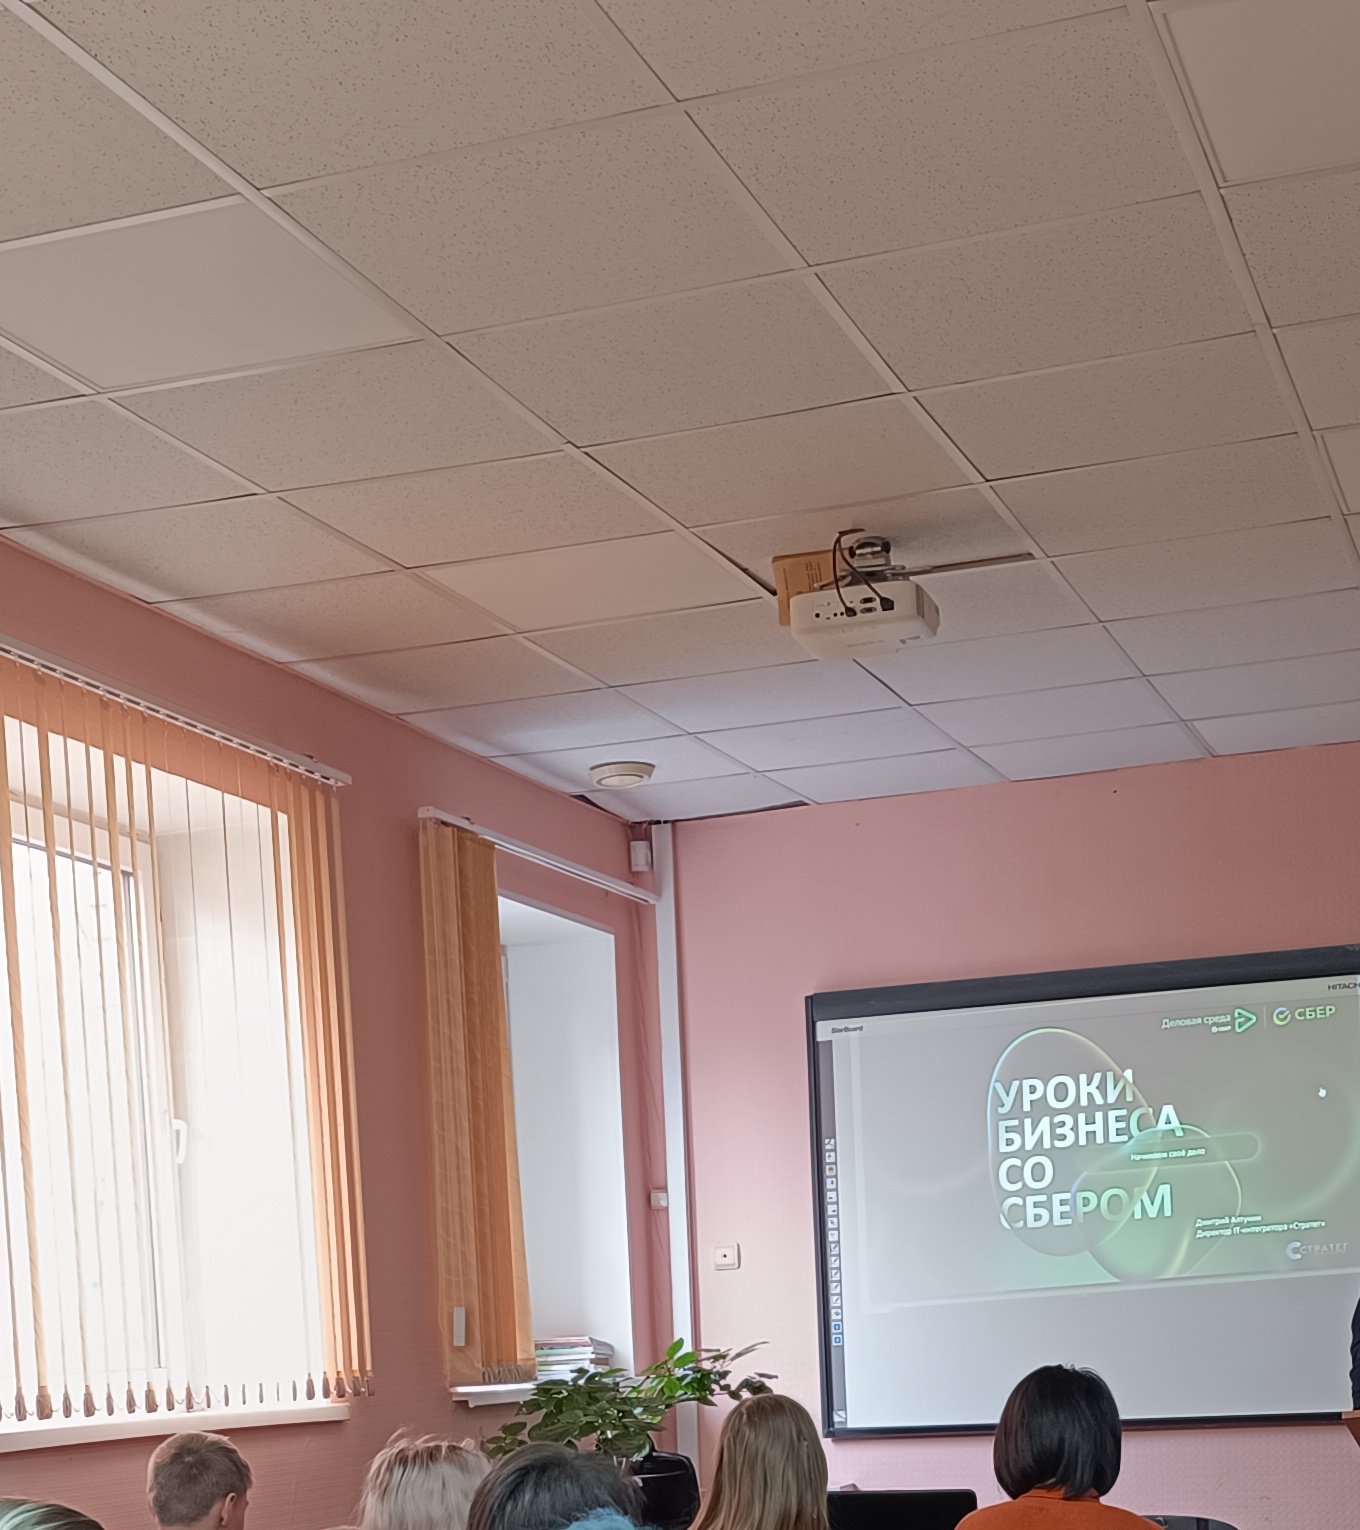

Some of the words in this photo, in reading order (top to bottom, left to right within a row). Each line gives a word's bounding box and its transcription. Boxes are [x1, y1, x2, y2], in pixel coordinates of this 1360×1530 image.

[1161, 1016, 1202, 1029] Деловая
[1203, 1013, 1232, 1026] среда
[1294, 1005, 1336, 1021] СБЕР
[993, 1068, 1134, 1114] УРОКИ
[998, 1104, 1184, 1153] БИЗНЕСА
[998, 1155, 1054, 1192] СО
[999, 1183, 1173, 1230] СБЕРОМ
[1299, 1242, 1349, 1254] СТРАТЕГ
